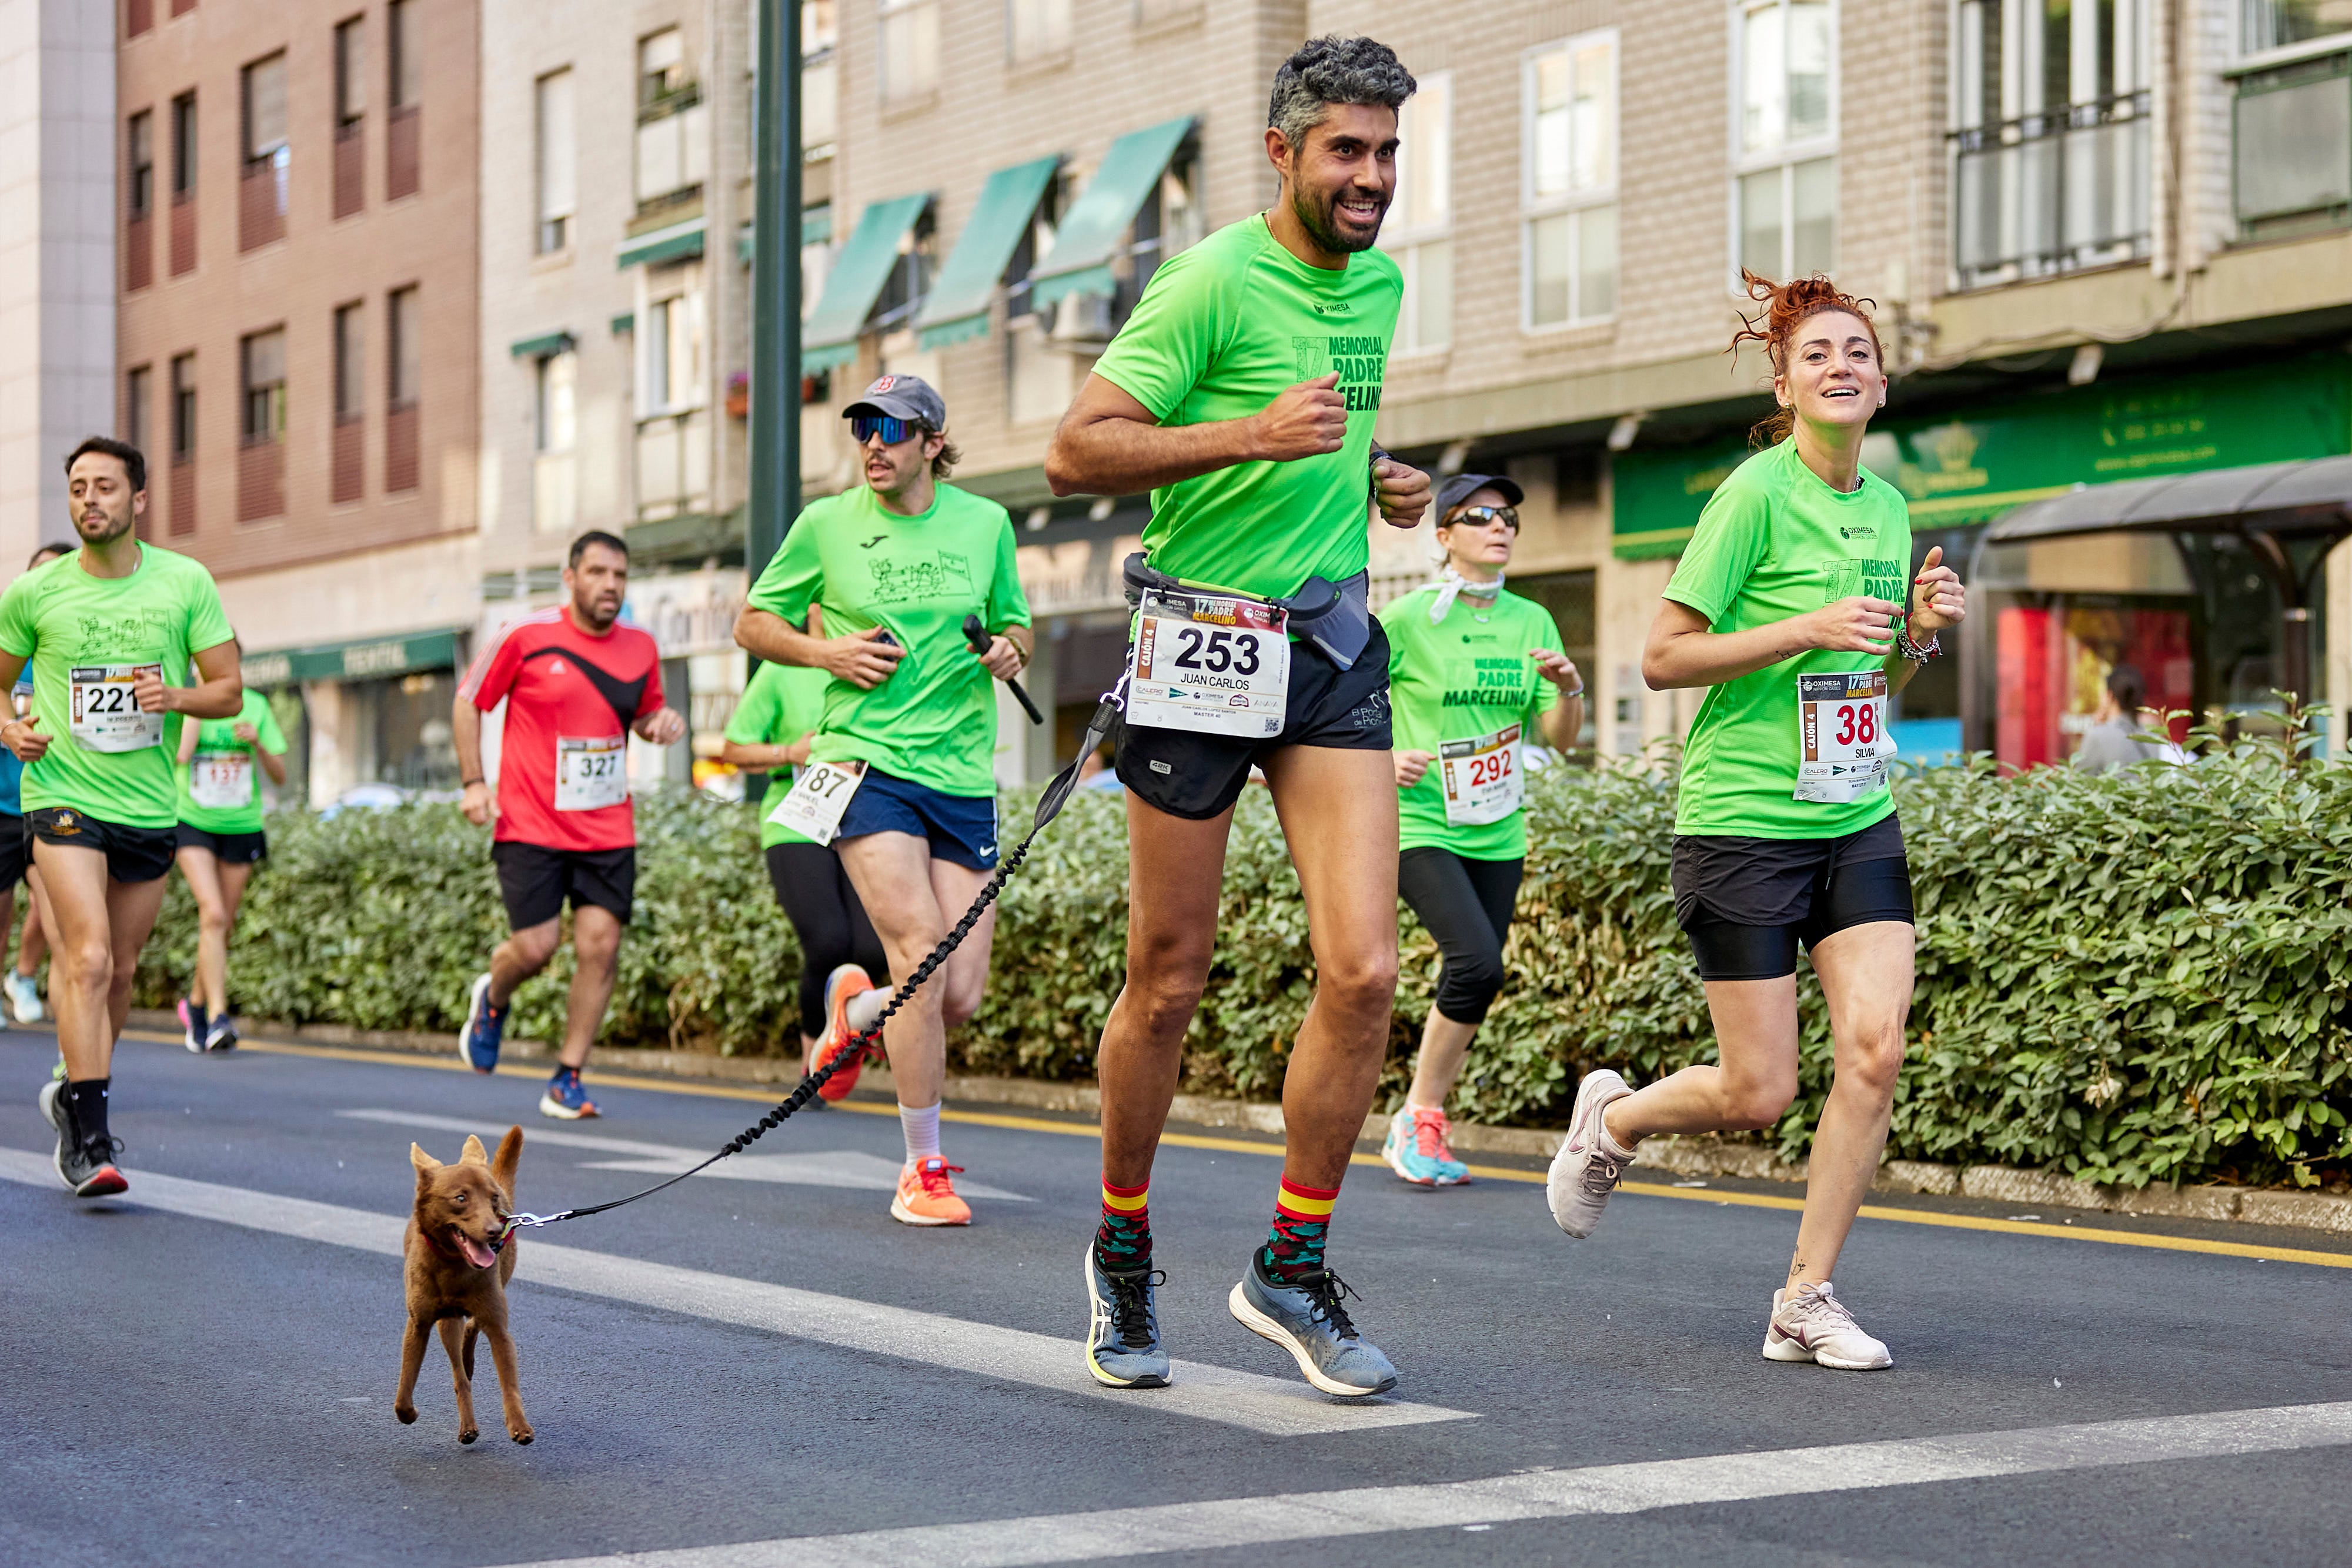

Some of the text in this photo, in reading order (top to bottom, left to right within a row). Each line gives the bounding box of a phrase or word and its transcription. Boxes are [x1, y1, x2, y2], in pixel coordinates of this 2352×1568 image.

[1328, 336, 1384, 356] MEMORIAL
[1332, 357, 1382, 382] PADRE
[876, 376, 894, 392] B
[1863, 579, 1905, 603] PADRE
[1194, 598, 1210, 613] 17
[1208, 600, 1237, 608] MEMORIAL
[1254, 609, 1271, 618] OXIM
[1208, 605, 1234, 617] PADRE
[1192, 611, 1237, 626] MARCELINO
[1174, 627, 1260, 676] 253
[1181, 673, 1250, 690] JUAN CARLOS
[1476, 671, 1523, 688] PADRE
[1847, 675, 1860, 690] 17
[88, 687, 138, 713] 221
[1442, 689, 1527, 707] MARCELINO
[1846, 687, 1873, 698] MARCELIN
[1855, 747, 1875, 758] SILVIA
[580, 755, 616, 778] 327
[1469, 749, 1512, 787] 292
